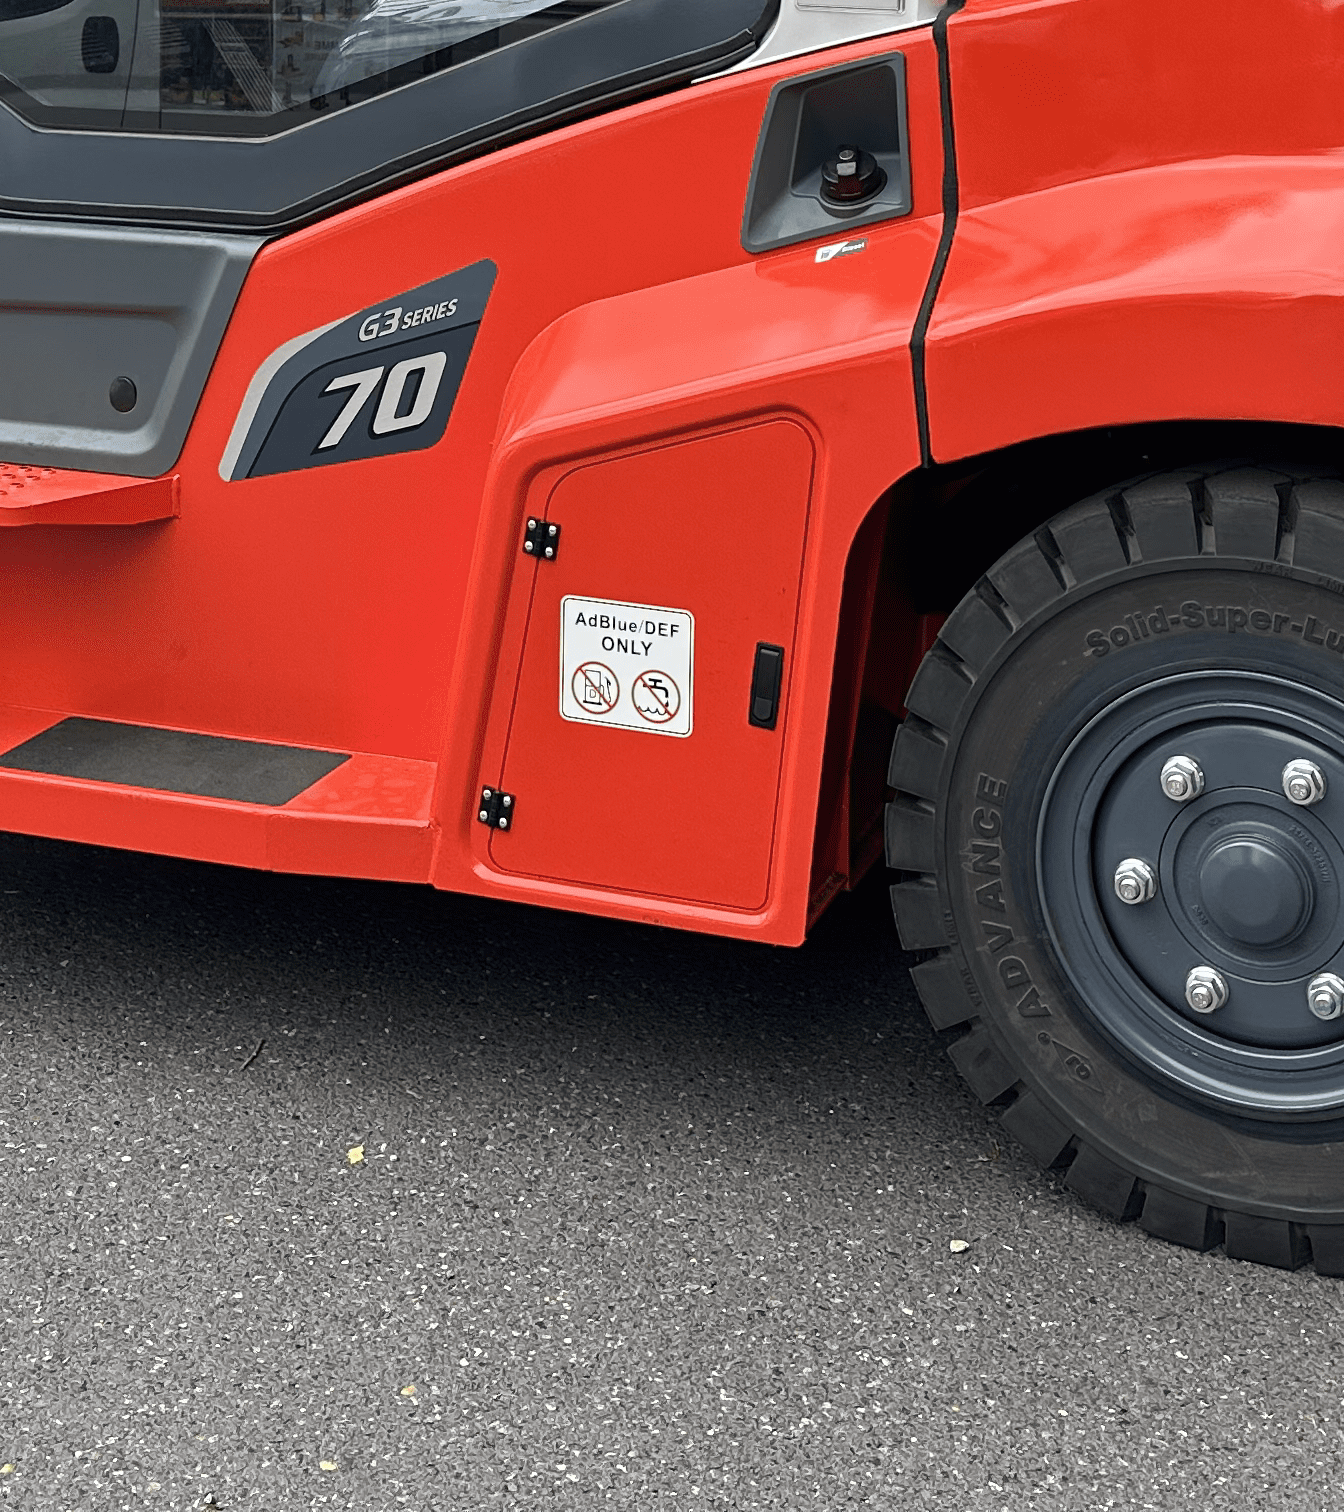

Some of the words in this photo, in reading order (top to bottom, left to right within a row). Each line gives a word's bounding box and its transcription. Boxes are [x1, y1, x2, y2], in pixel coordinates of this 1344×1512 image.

[358, 306, 402, 342] G3
[400, 298, 459, 331] SERIES
[317, 351, 447, 450] 70
[574, 611, 681, 638] AdBlue/DEF
[601, 636, 653, 657] ONLY
[970, 771, 1053, 1019] ADVANCE
